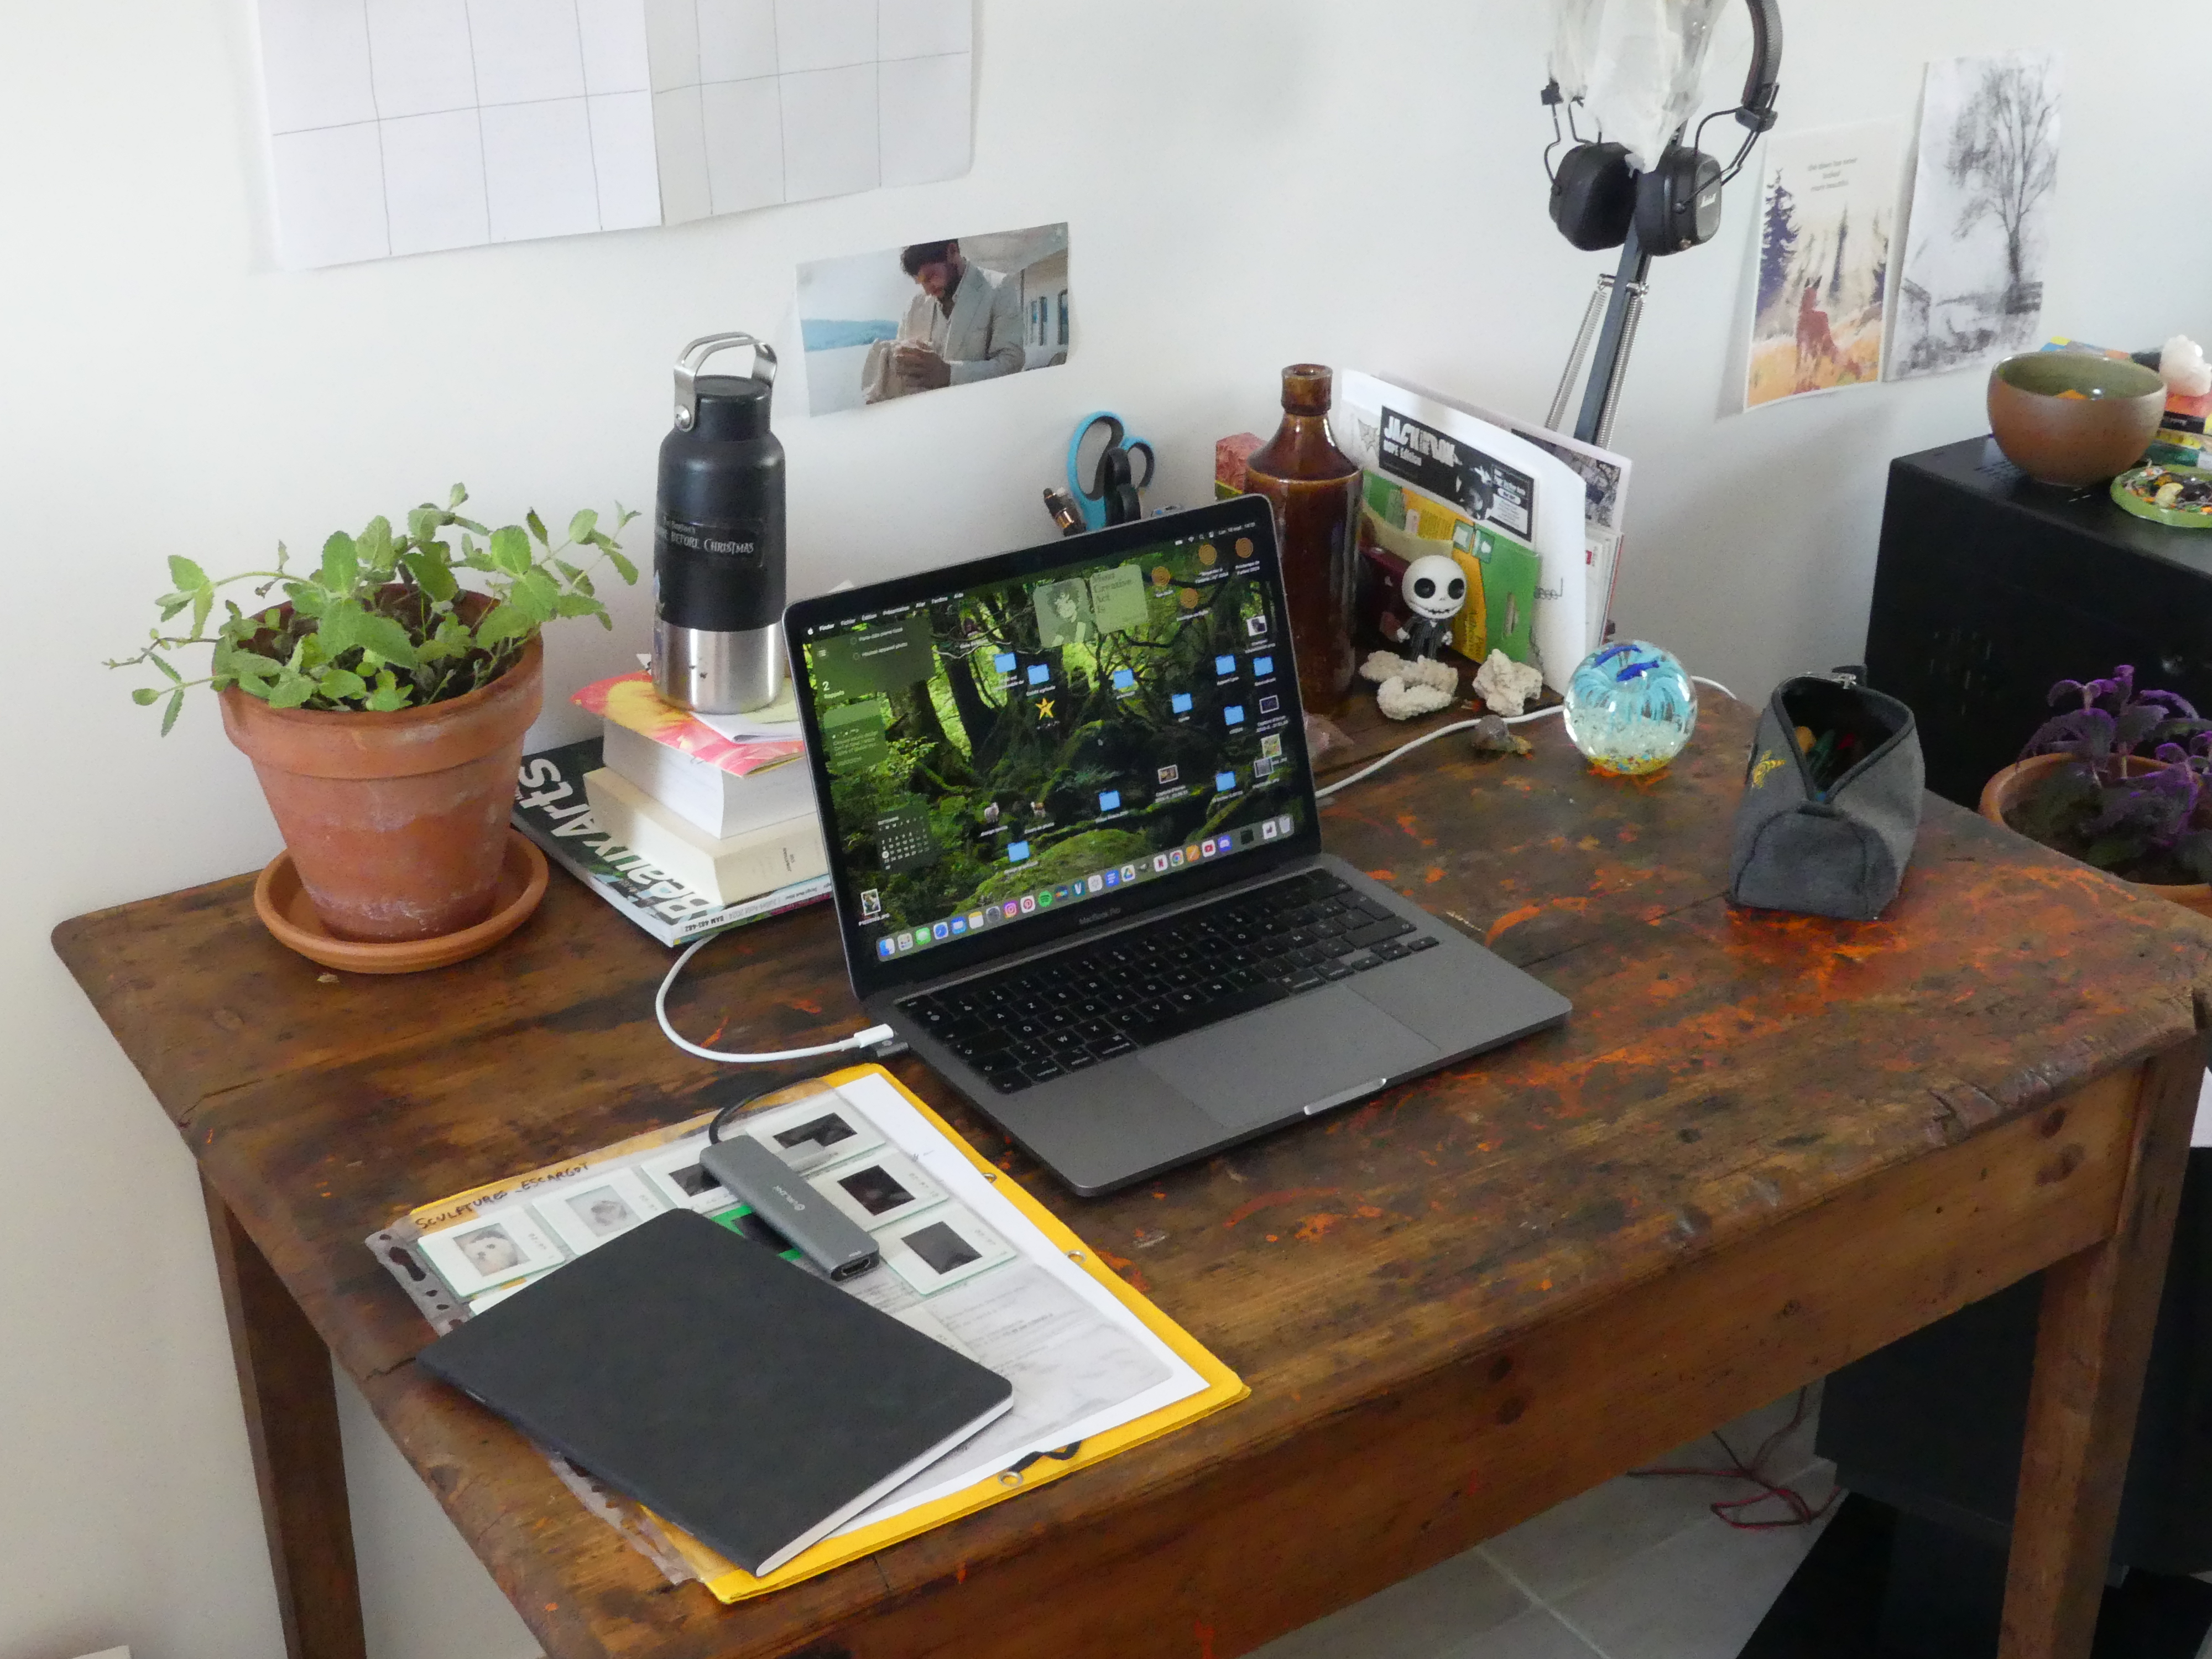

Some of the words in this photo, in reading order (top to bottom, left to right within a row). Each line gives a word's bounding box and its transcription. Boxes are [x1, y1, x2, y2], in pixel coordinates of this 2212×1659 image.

[704, 538, 754, 555] CHRISTMAS
[822, 681, 830, 691] 2
[521, 1162, 589, 1190] ESCARGOT
